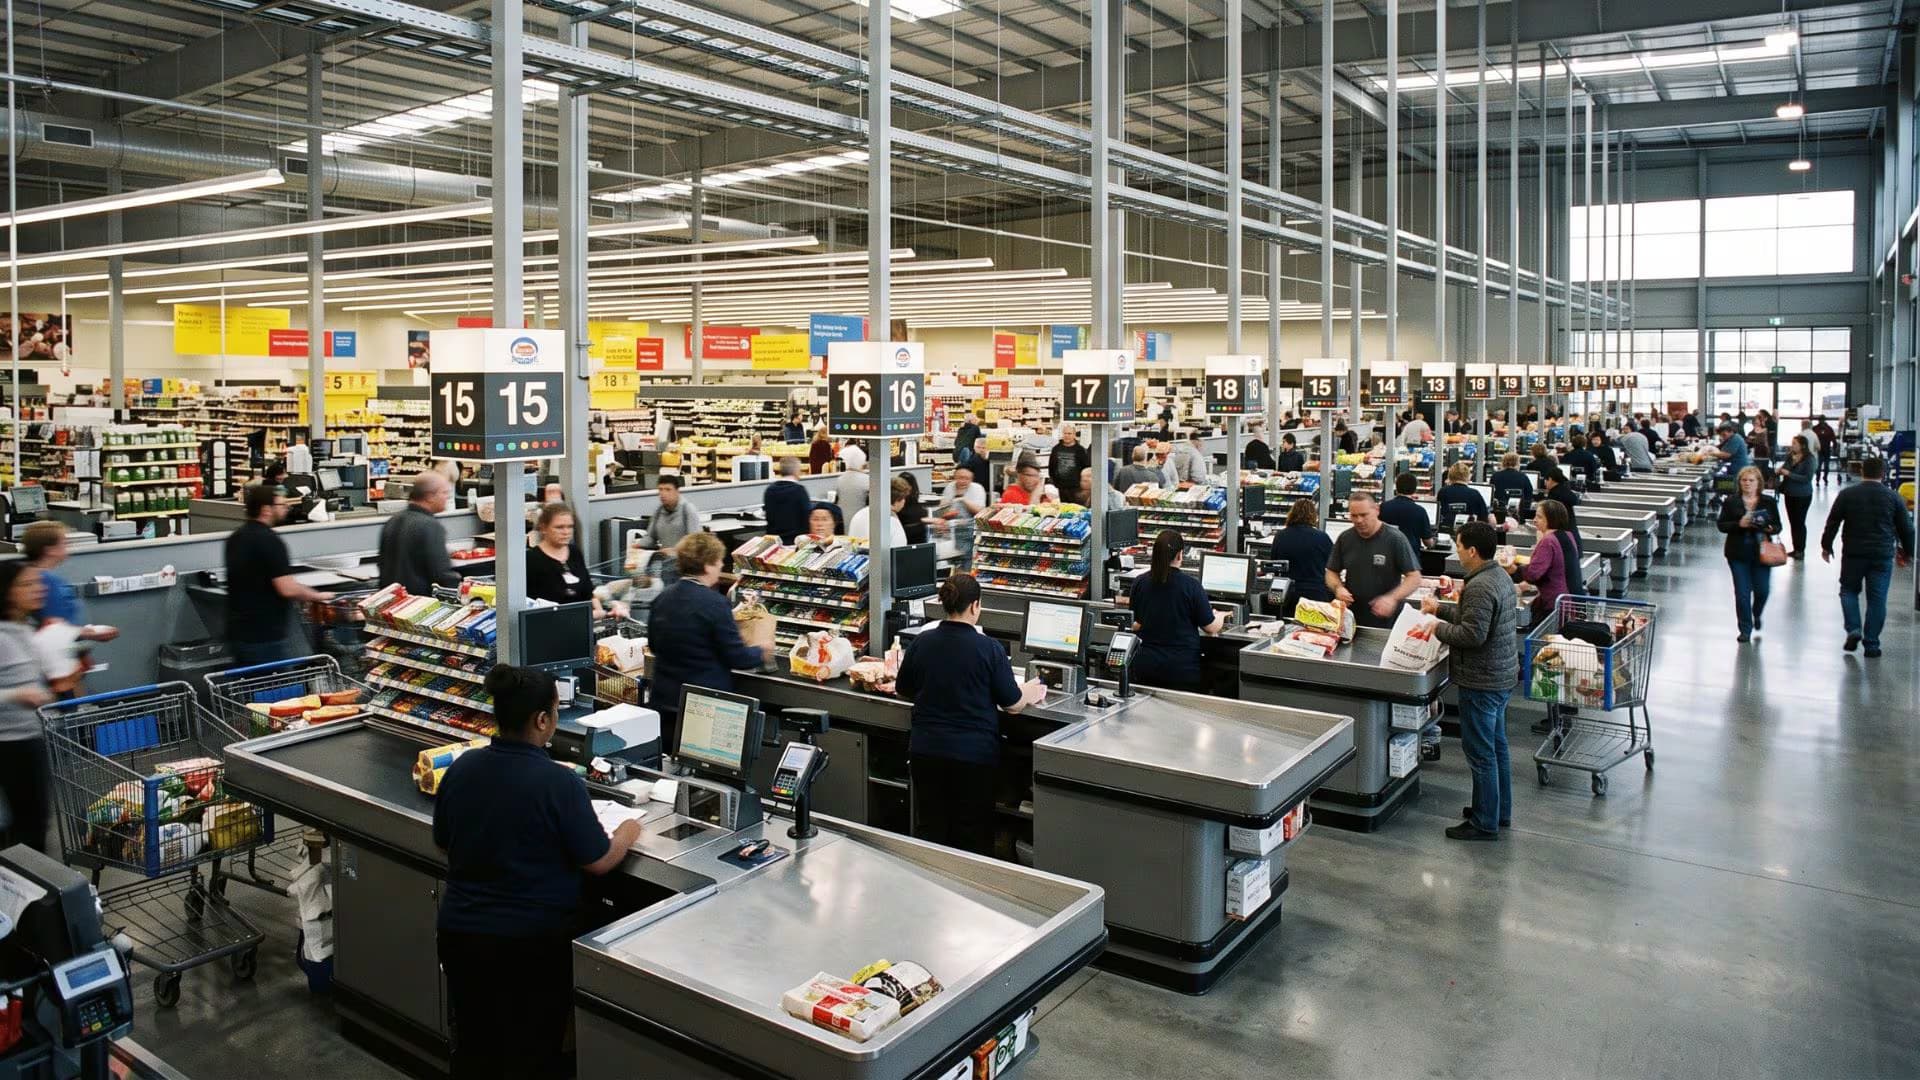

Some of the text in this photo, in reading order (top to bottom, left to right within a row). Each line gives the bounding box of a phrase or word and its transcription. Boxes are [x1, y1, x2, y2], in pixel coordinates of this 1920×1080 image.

[334, 376, 342, 389] 5
[1071, 379, 1101, 404] 17
[1114, 379, 1130, 404] 17
[1213, 379, 1238, 400] 18
[1248, 379, 1258, 400] 18
[1310, 378, 1331, 396] 15
[1376, 378, 1396, 394] 14
[1427, 378, 1445, 392] 13
[1470, 378, 1486, 390] 18
[1504, 377, 1518, 388] 19
[1532, 377, 1546, 387] 15
[440, 382, 474, 426] 15
[500, 382, 548, 426] 15
[838, 380, 872, 413] 16
[889, 380, 916, 413] 16
